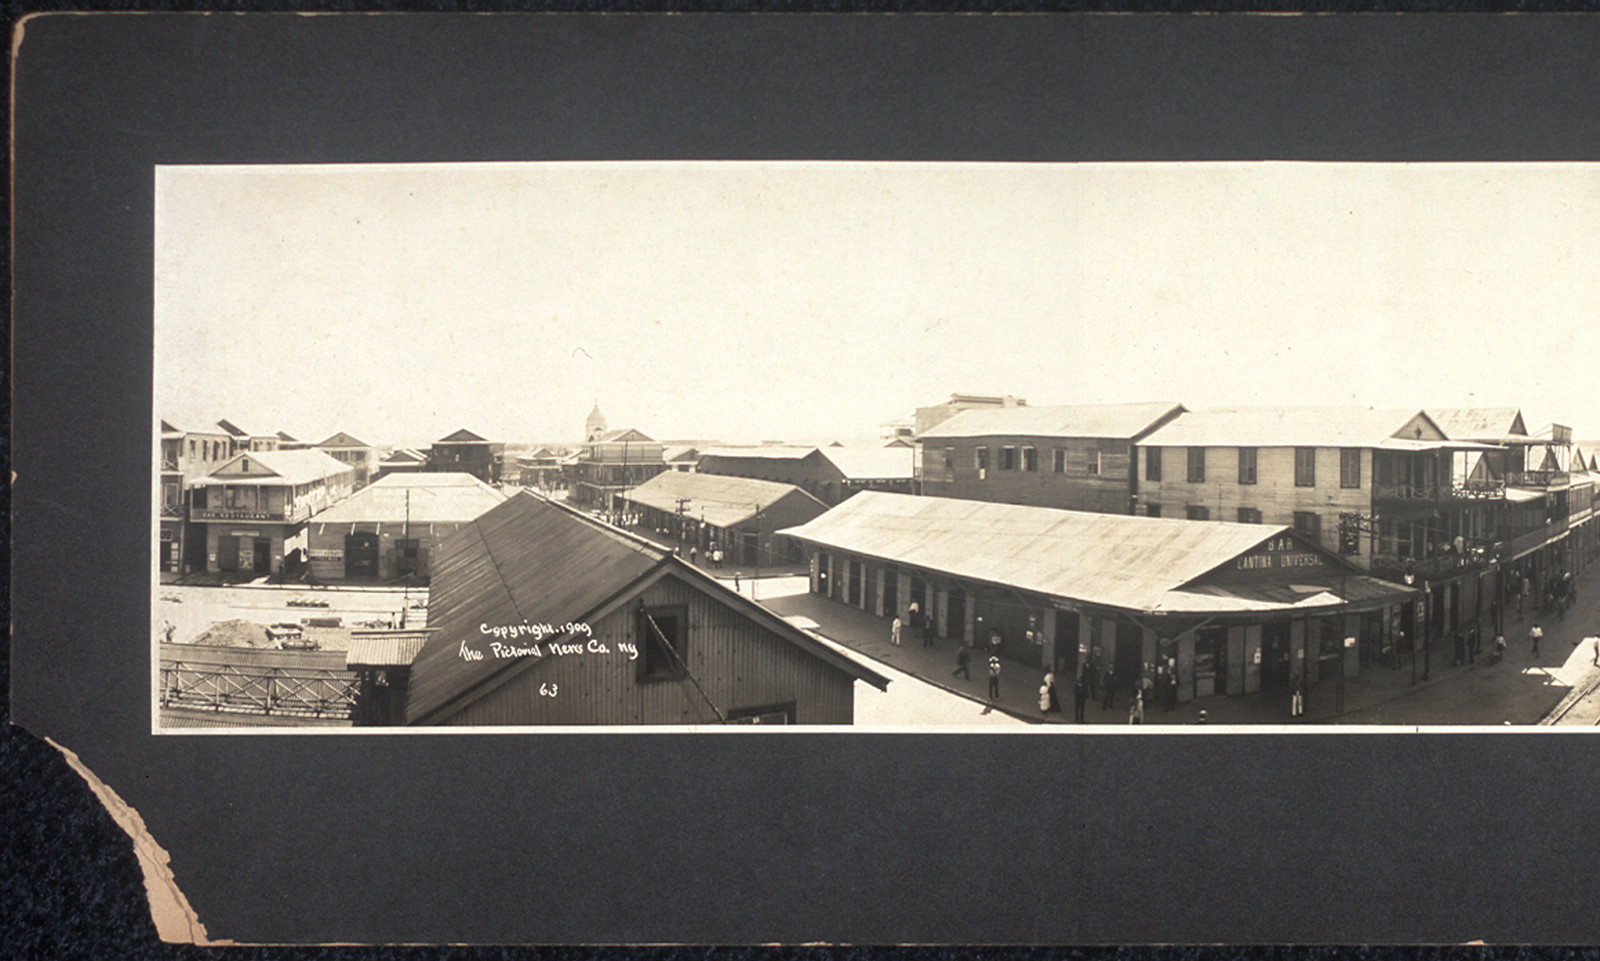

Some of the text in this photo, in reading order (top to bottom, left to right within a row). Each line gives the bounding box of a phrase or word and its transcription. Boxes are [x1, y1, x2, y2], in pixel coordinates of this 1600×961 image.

[1268, 538, 1293, 551] BAR
[1237, 552, 1324, 570] CANTINA UNIVERSAL
